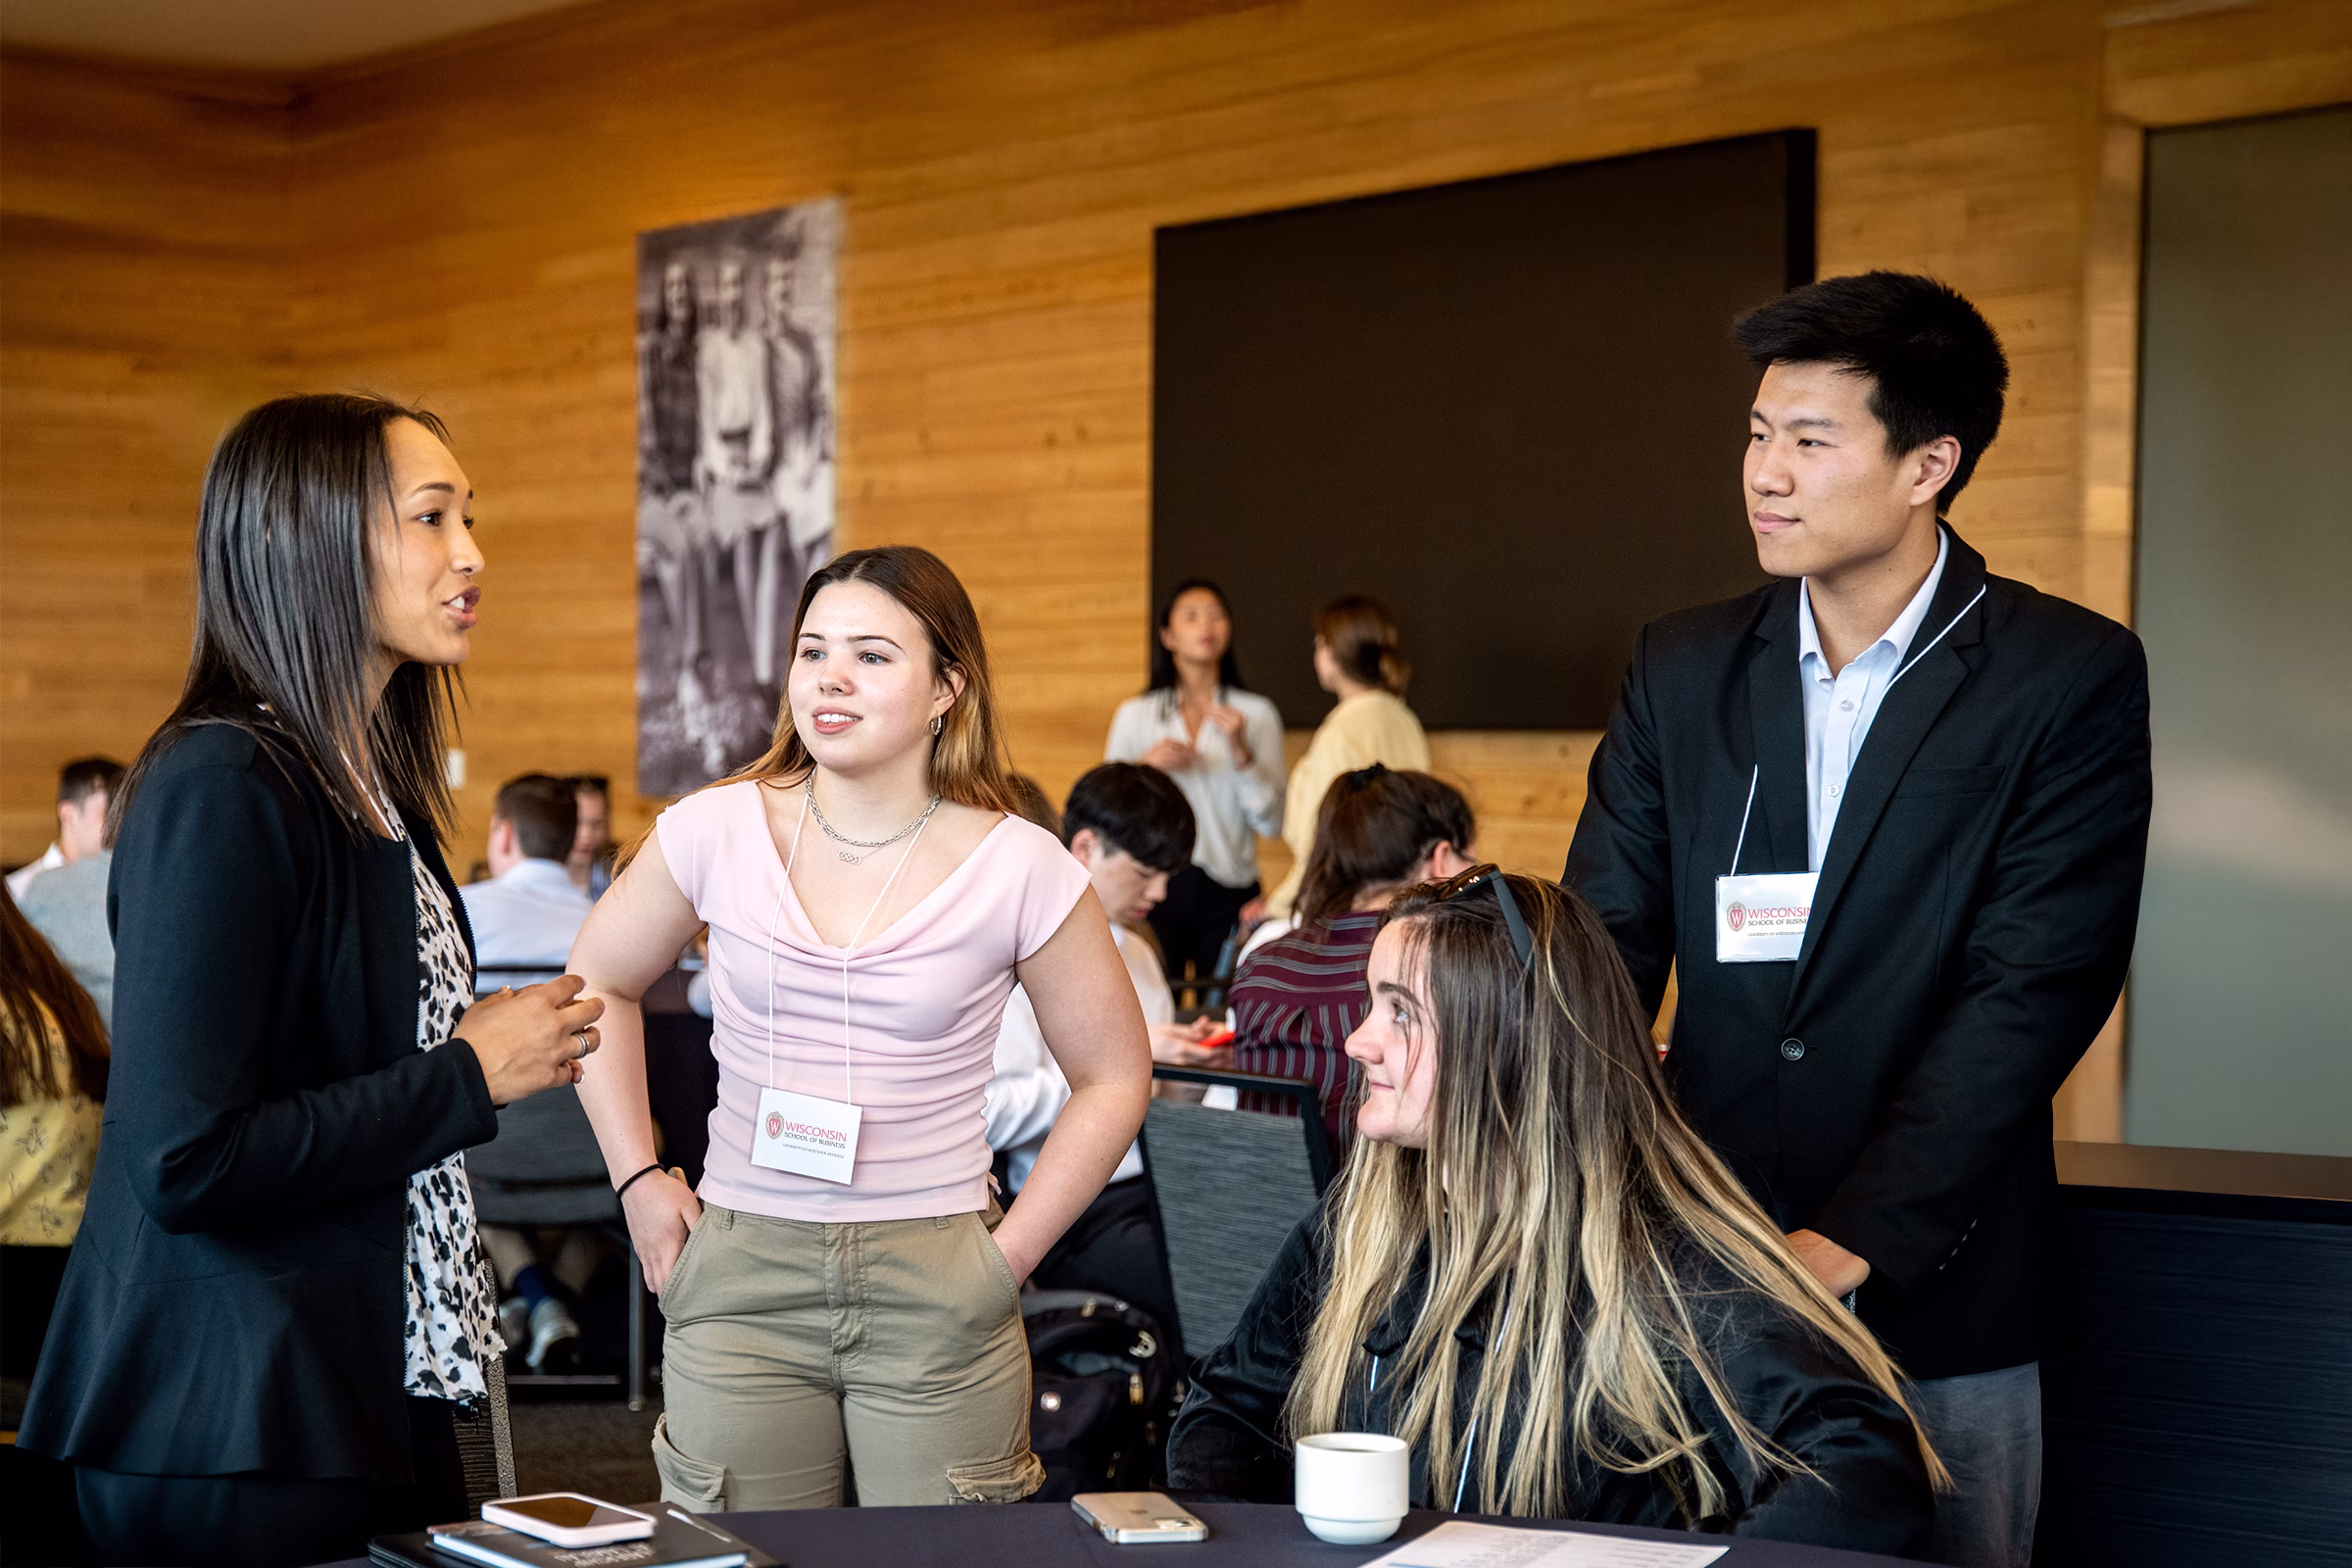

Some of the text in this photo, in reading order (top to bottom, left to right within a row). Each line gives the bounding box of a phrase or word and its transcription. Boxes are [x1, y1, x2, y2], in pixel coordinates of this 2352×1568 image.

[784, 1132, 808, 1142] SCHOOL
[818, 1138, 845, 1149] BUSINESS
[785, 1121, 847, 1142] WISCONSIN
